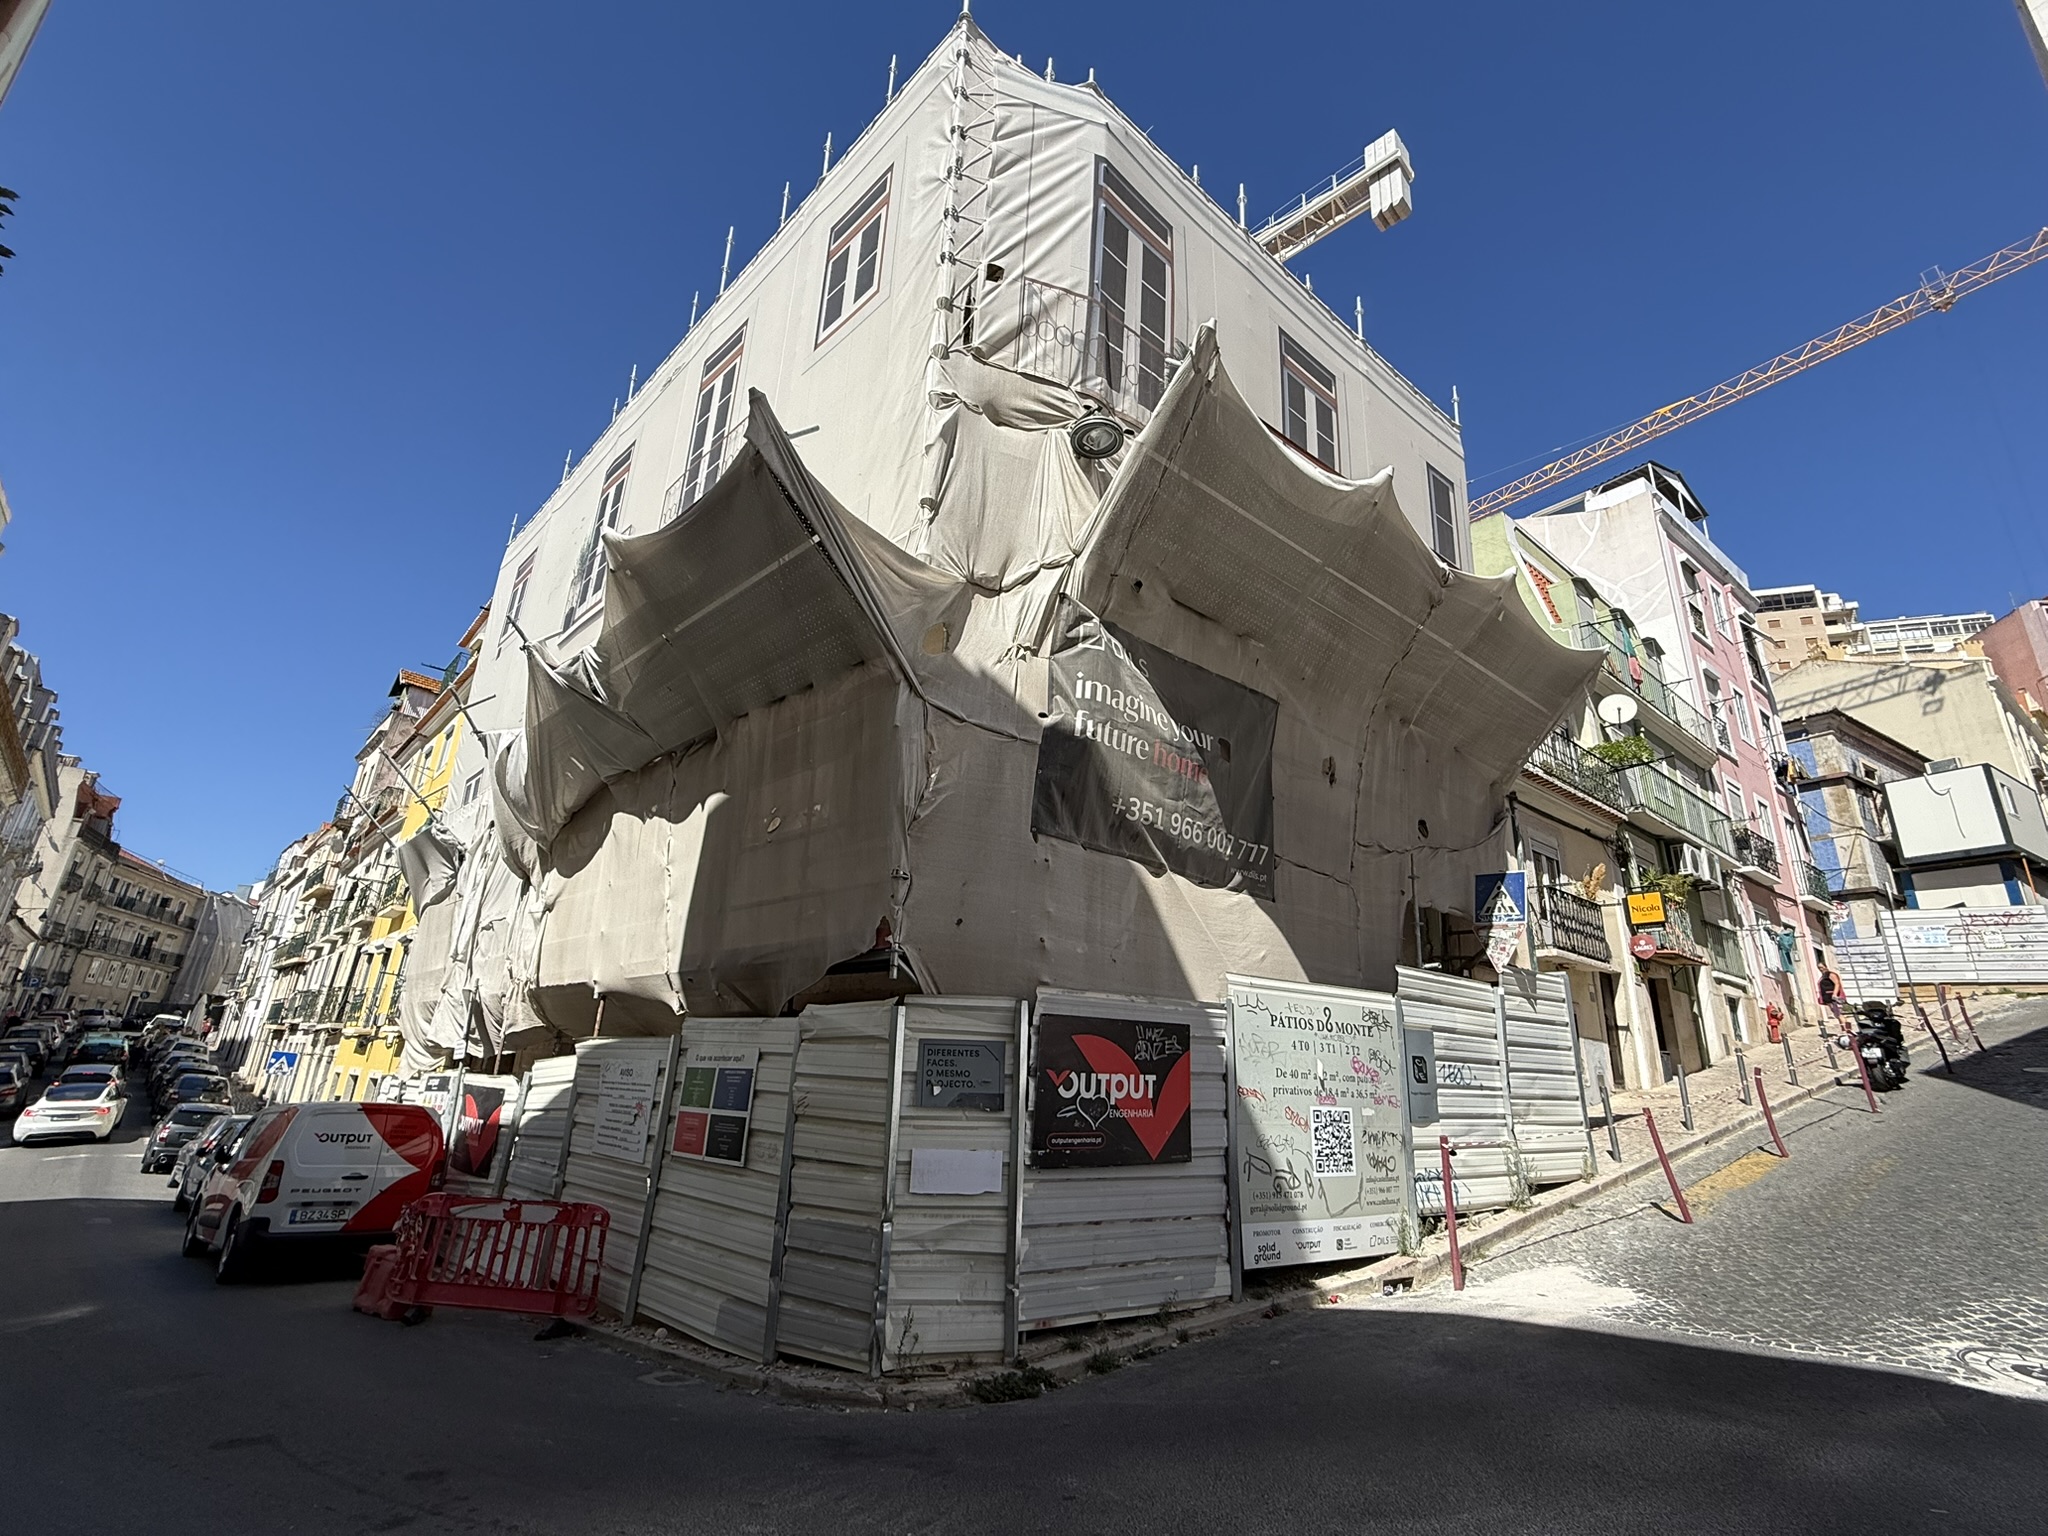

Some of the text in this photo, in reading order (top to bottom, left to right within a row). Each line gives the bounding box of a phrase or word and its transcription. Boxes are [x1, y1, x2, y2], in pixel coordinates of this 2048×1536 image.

[1074, 671, 1214, 752] imagine your
[1074, 709, 1210, 787] future home
[1111, 797, 1269, 866] +351 966 007 777
[1631, 903, 1660, 913] Nicola
[1270, 1012, 1315, 1032] PÁTIOS
[1335, 1020, 1375, 1038] MONTE
[927, 1048, 980, 1058] DIFERENTES
[1291, 1040, 1297, 1051] 4
[1319, 1042, 1325, 1053] 3
[1325, 1043, 1337, 1054] T1
[1345, 1045, 1351, 1056] 2
[1351, 1045, 1361, 1056] T2
[926, 1058, 957, 1067] FACES.
[620, 1068, 634, 1077] AVISO
[926, 1068, 971, 1078] O MESMO
[1275, 1067, 1288, 1079] De
[1289, 1068, 1299, 1080] 40
[1301, 1068, 1312, 1080] m²
[1342, 1074, 1356, 1083] com
[926, 1079, 976, 1089] POJECTO.
[1056, 1070, 1157, 1106] OUTPUT
[1273, 1084, 1313, 1098] privativos
[1340, 1087, 1350, 1098] m²
[1355, 1089, 1369, 1100] 36,5
[1109, 1108, 1154, 1119] ENGENHARIA
[317, 1132, 374, 1145] OUTPUT
[1051, 1136, 1103, 1147] outputengenharia.pt
[1252, 1191, 1271, 1201] (+351)
[1252, 1228, 1281, 1238] PROMOTOR
[1292, 1224, 1324, 1235] CONSTRUÇÃO
[1297, 1240, 1321, 1250] OUTPUT
[1377, 1235, 1389, 1246] DILS
[1253, 1251, 1281, 1265] ground
